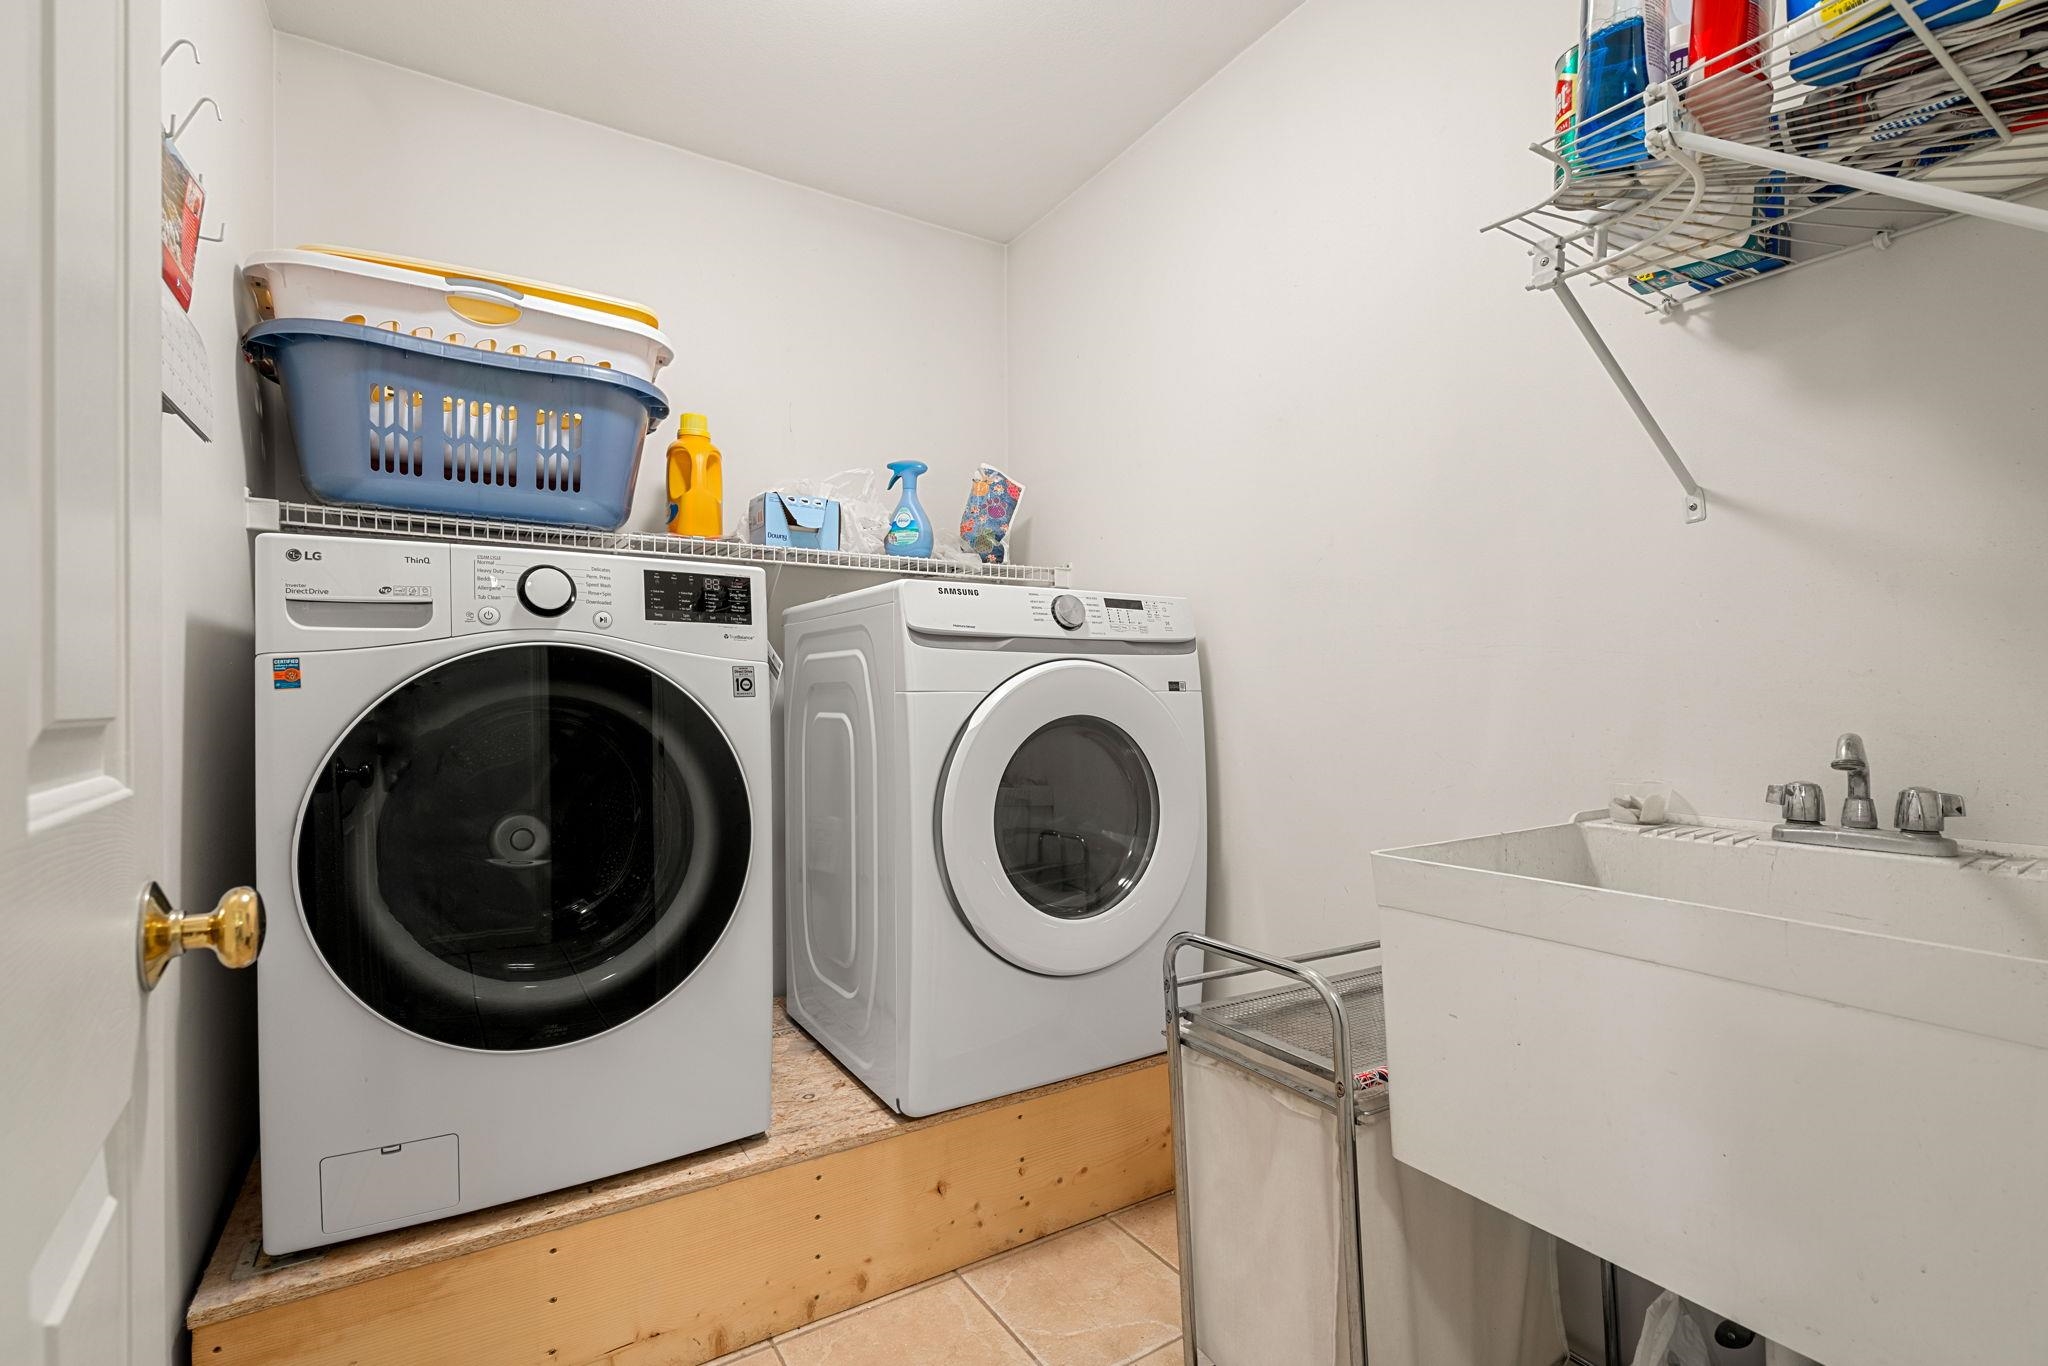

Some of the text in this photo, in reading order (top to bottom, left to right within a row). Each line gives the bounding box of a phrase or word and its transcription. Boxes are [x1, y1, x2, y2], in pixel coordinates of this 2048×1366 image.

[767, 531, 788, 542] Downy
[304, 551, 322, 561] LG
[404, 556, 431, 565] ThinQ
[937, 587, 980, 597] SAMSUNG
[735, 677, 753, 692] 10
